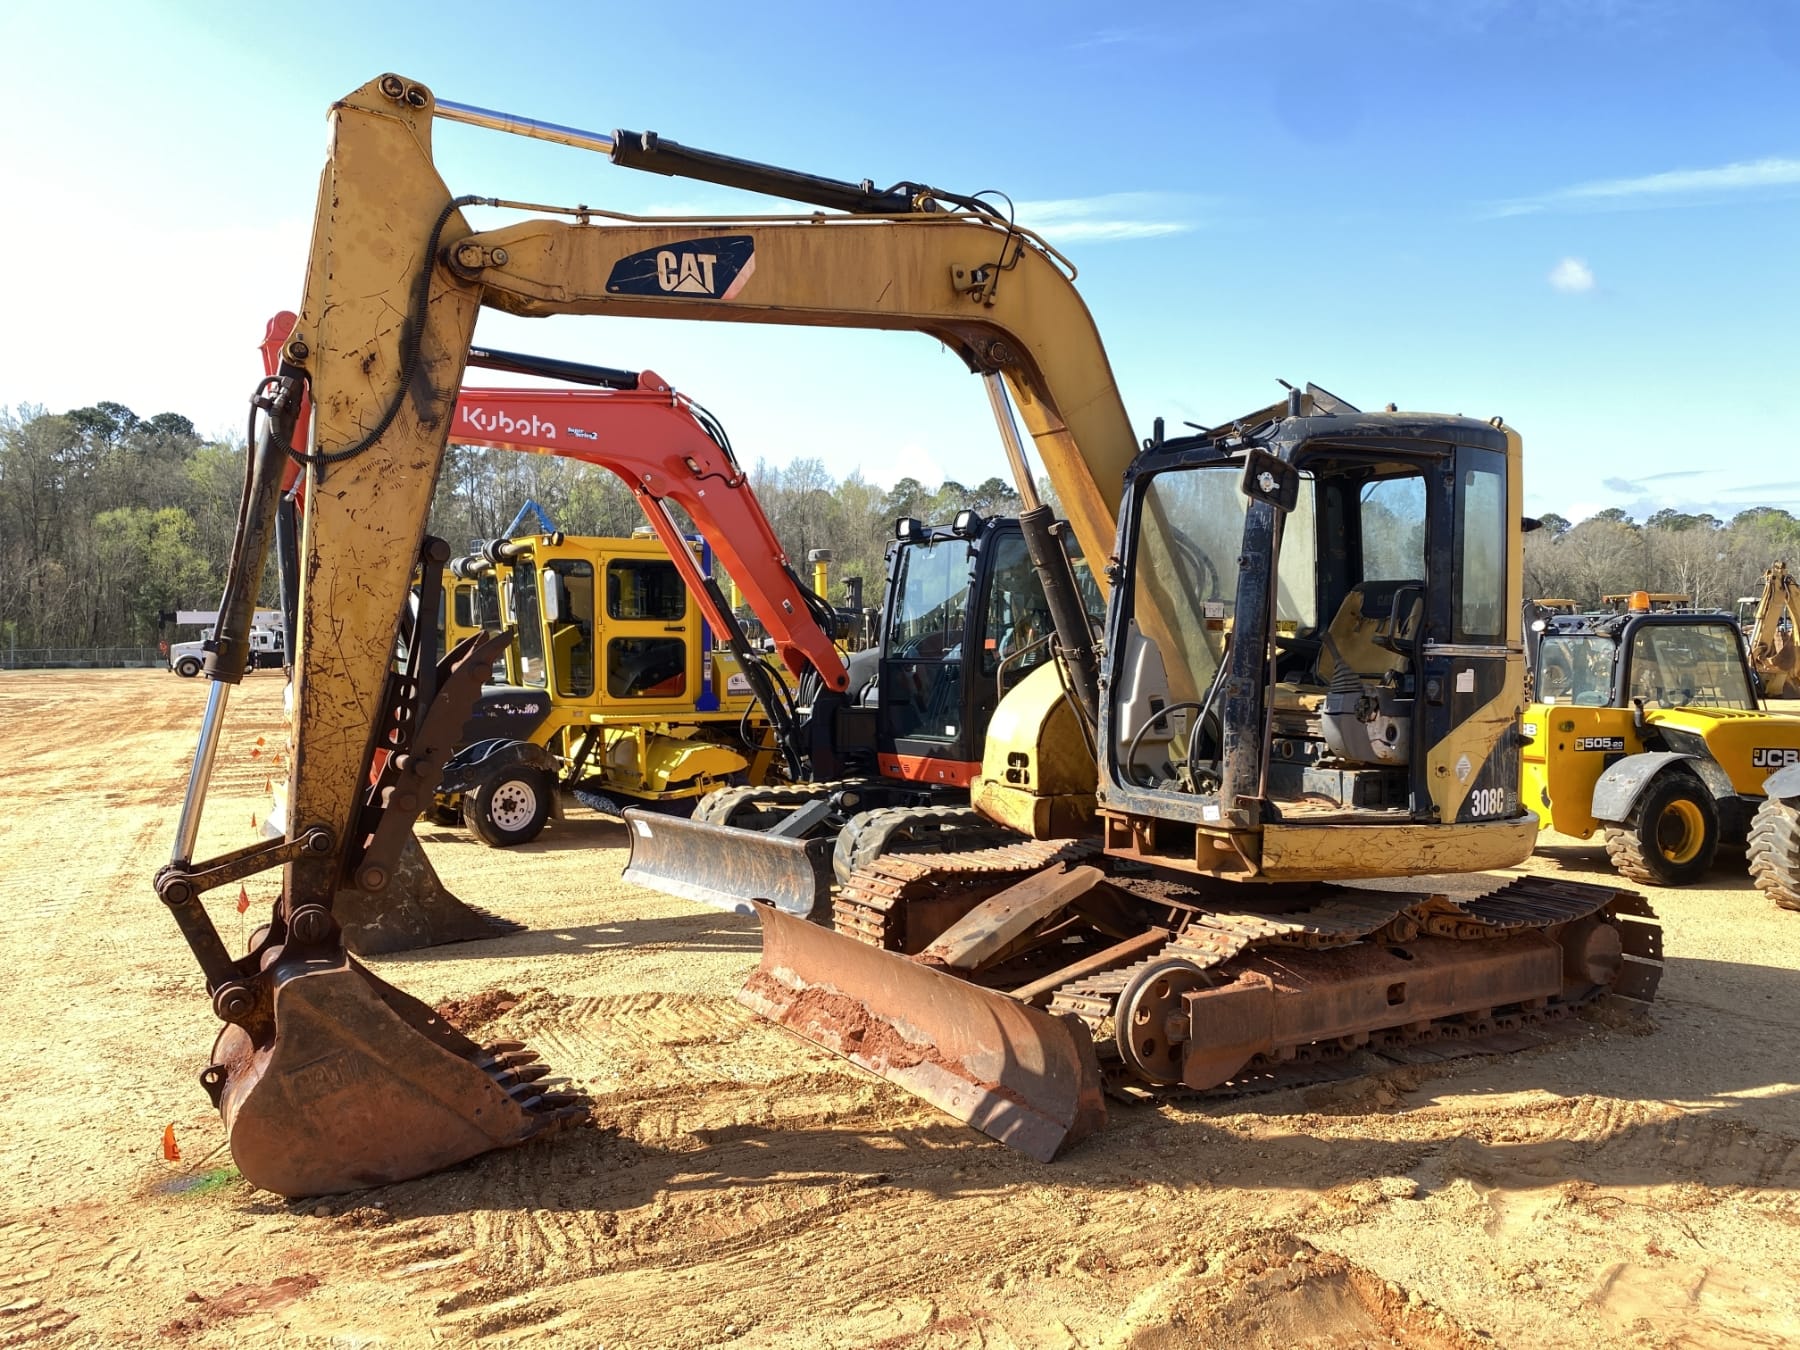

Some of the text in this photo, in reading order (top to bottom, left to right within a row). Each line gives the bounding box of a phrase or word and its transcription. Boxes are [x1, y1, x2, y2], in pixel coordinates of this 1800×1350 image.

[656, 251, 717, 294] CAT
[463, 406, 556, 439] Kubota
[1753, 749, 1799, 767] JCB
[1471, 787, 1504, 816] 308C
